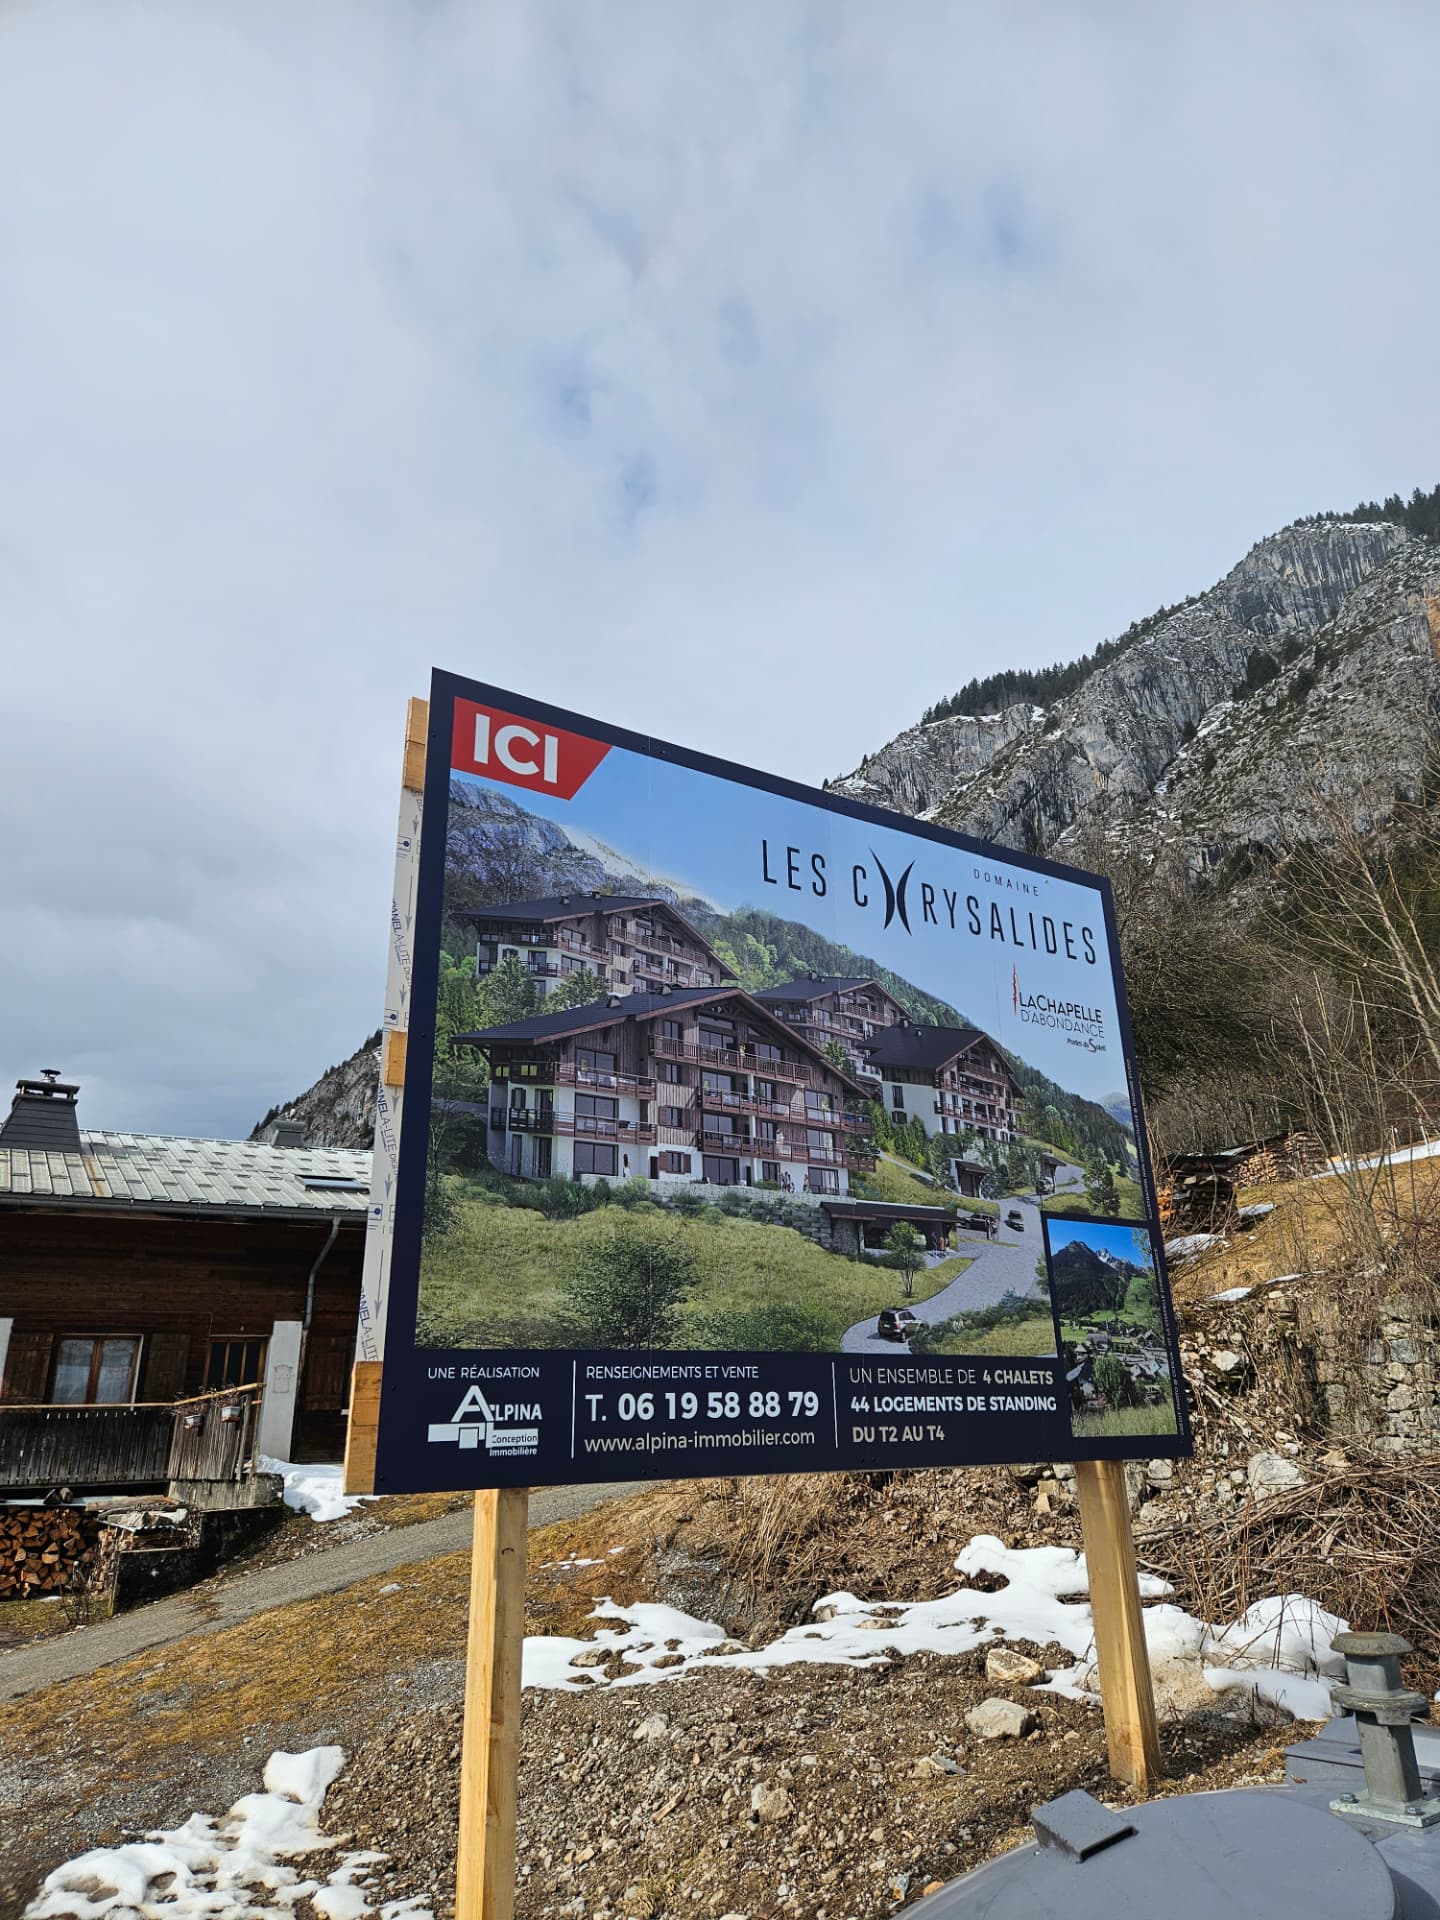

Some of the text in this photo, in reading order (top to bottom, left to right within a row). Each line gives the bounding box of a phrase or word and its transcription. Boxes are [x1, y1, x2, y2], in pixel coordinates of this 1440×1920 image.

[473, 712, 559, 784] ICI
[762, 839, 827, 897] LES
[973, 868, 1040, 897] DOMAINE
[1020, 1009, 1105, 1039] D'ABONDANCE
[427, 1364, 540, 1379] UNE RÉALISATION
[586, 1366, 759, 1380] RENSEIGNEMENTS ET VENTE
[849, 1368, 1054, 1385] UN ENSEMBLE DE 4 CHALETS
[450, 1384, 543, 1423] ALPINA
[585, 1391, 819, 1422] T. 06 19 58 88 79
[851, 1396, 1057, 1413] 44 LOGEMENTS DE STANDING
[492, 1434, 538, 1445] Conception
[584, 1429, 815, 1454] www.alpina-immobilier.com
[852, 1425, 945, 1443] DU T2 AU T4
